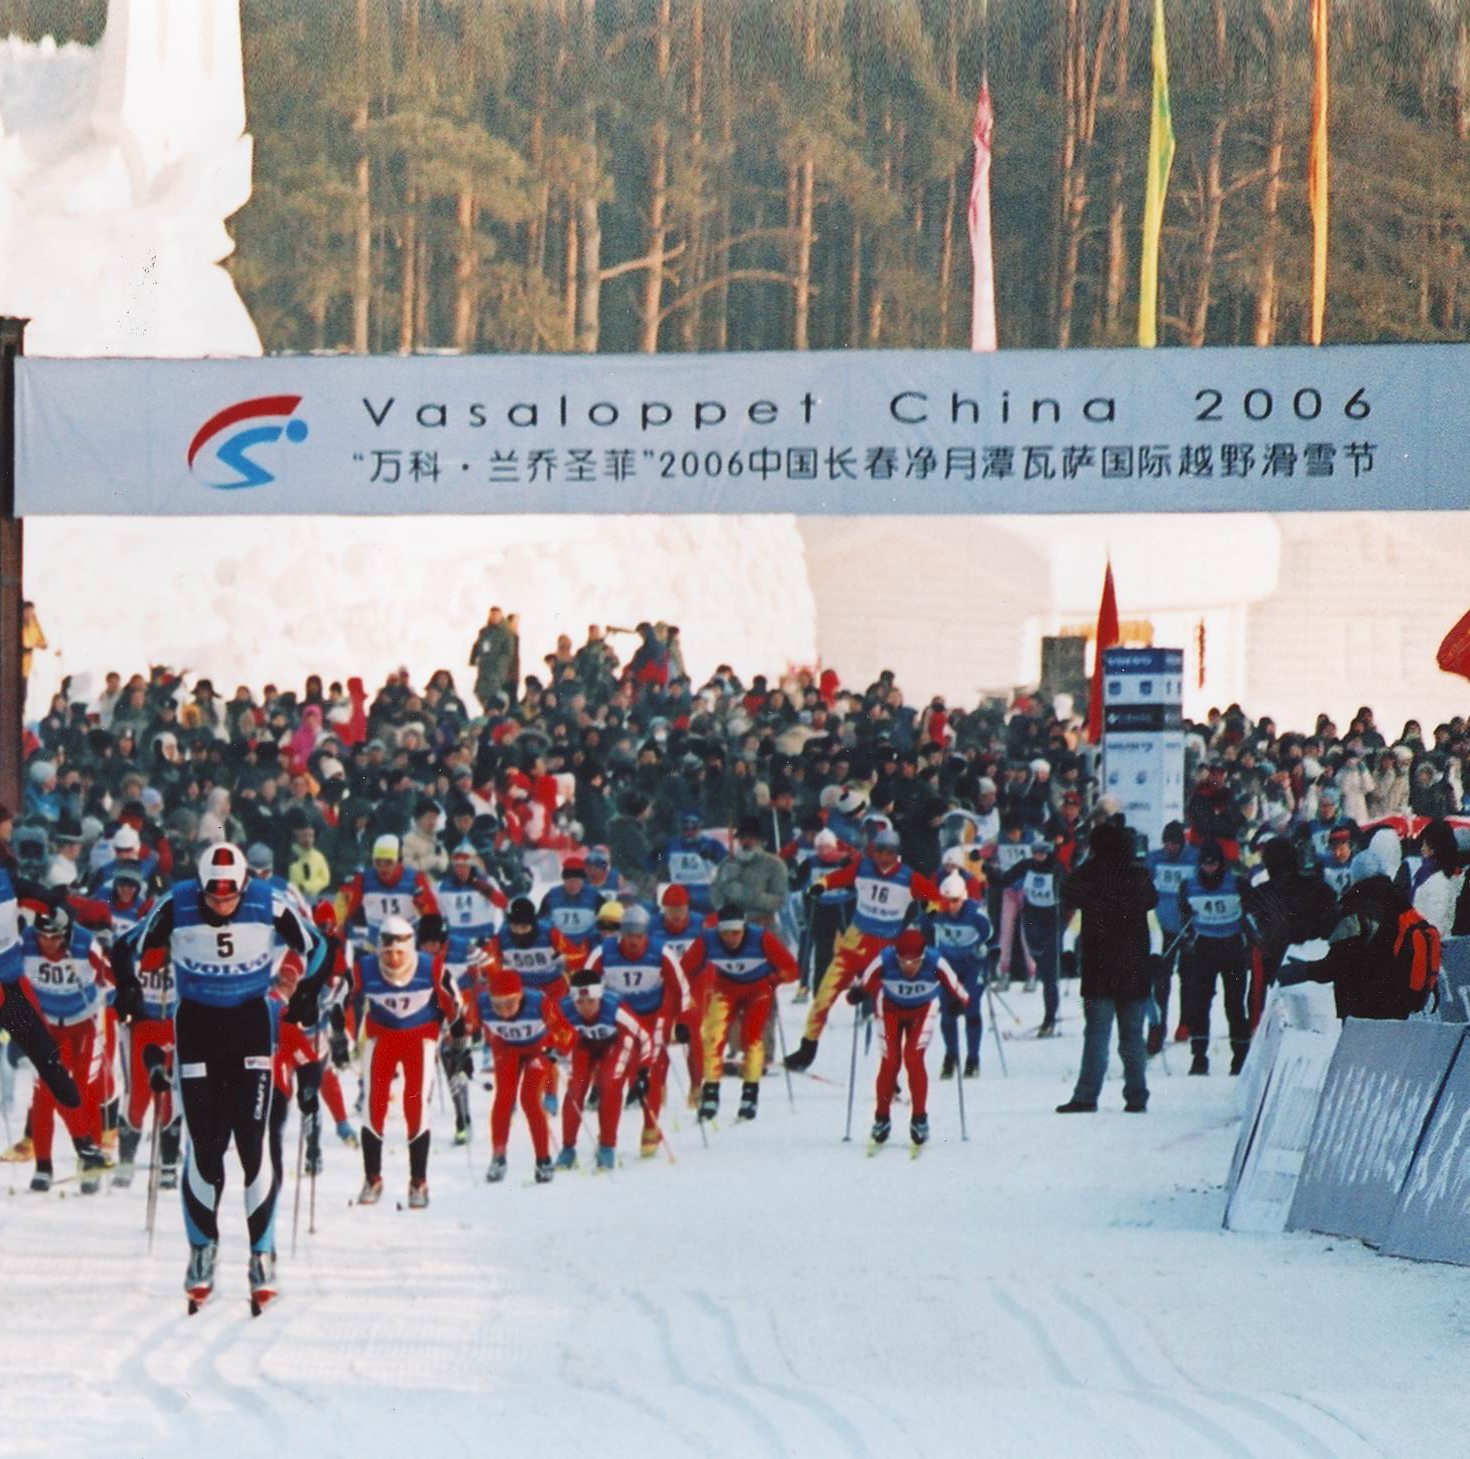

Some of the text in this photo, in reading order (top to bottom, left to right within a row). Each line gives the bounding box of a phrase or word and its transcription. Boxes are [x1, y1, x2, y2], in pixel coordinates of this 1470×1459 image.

[362, 387, 1371, 430] Vasaloppet China 2006
[871, 885, 889, 904] 16
[216, 932, 234, 958] 5
[623, 971, 643, 987] 17
